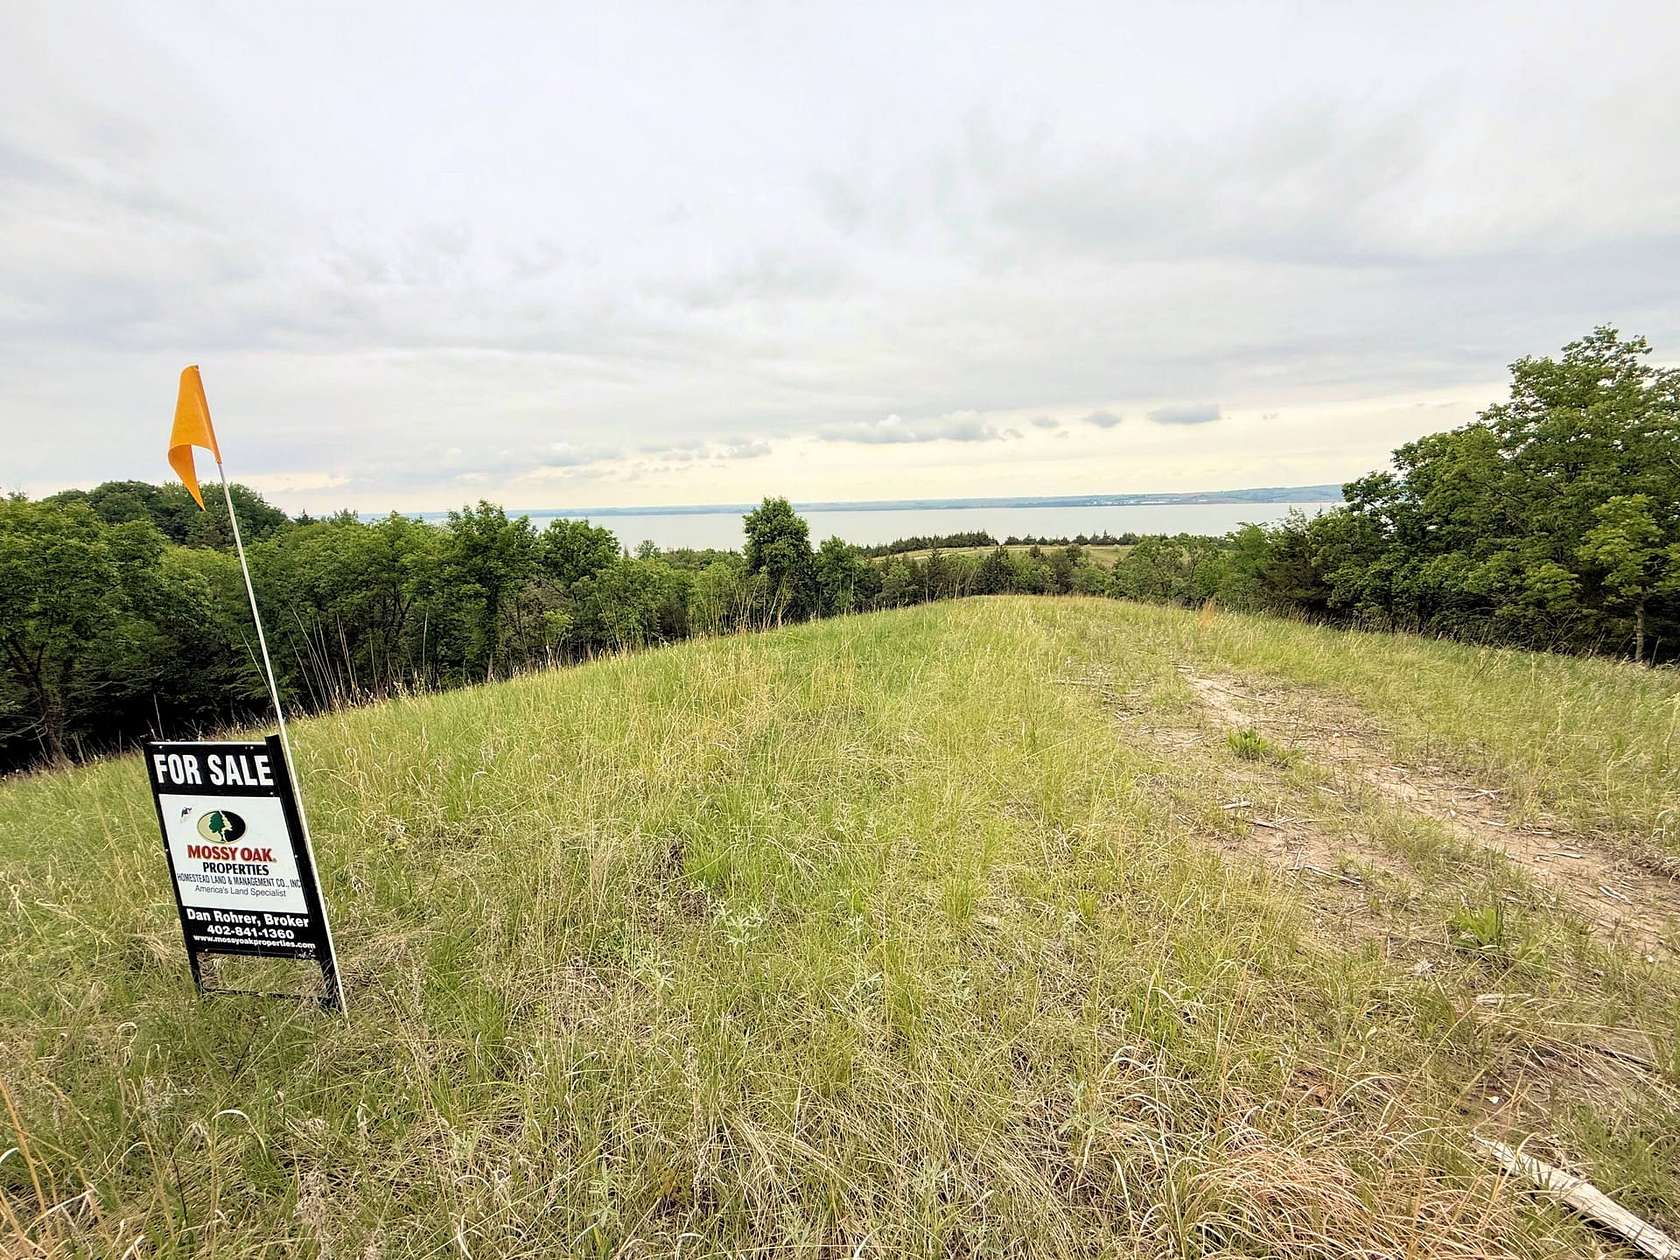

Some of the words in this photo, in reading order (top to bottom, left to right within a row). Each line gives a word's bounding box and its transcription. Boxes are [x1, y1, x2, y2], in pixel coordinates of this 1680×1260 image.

[153, 754, 202, 785] FOR
[207, 754, 274, 786] SALE
[187, 845, 238, 861] MOSSY
[240, 847, 272, 862] OAK
[202, 862, 270, 876] PROPERTIES
[177, 872, 210, 884] HOMESTEAD
[211, 875, 227, 885] LAND
[233, 876, 275, 887] MANAGEMENT
[195, 884, 229, 895] America's
[230, 887, 249, 896] Land
[250, 887, 287, 898] Specialist
[186, 908, 211, 921] Dan
[213, 910, 261, 927] Rohrer,
[263, 913, 309, 928] Broker
[207, 925, 295, 939] 402-841-1360
[193, 934, 316, 949] www.mossyoakproperties.com
